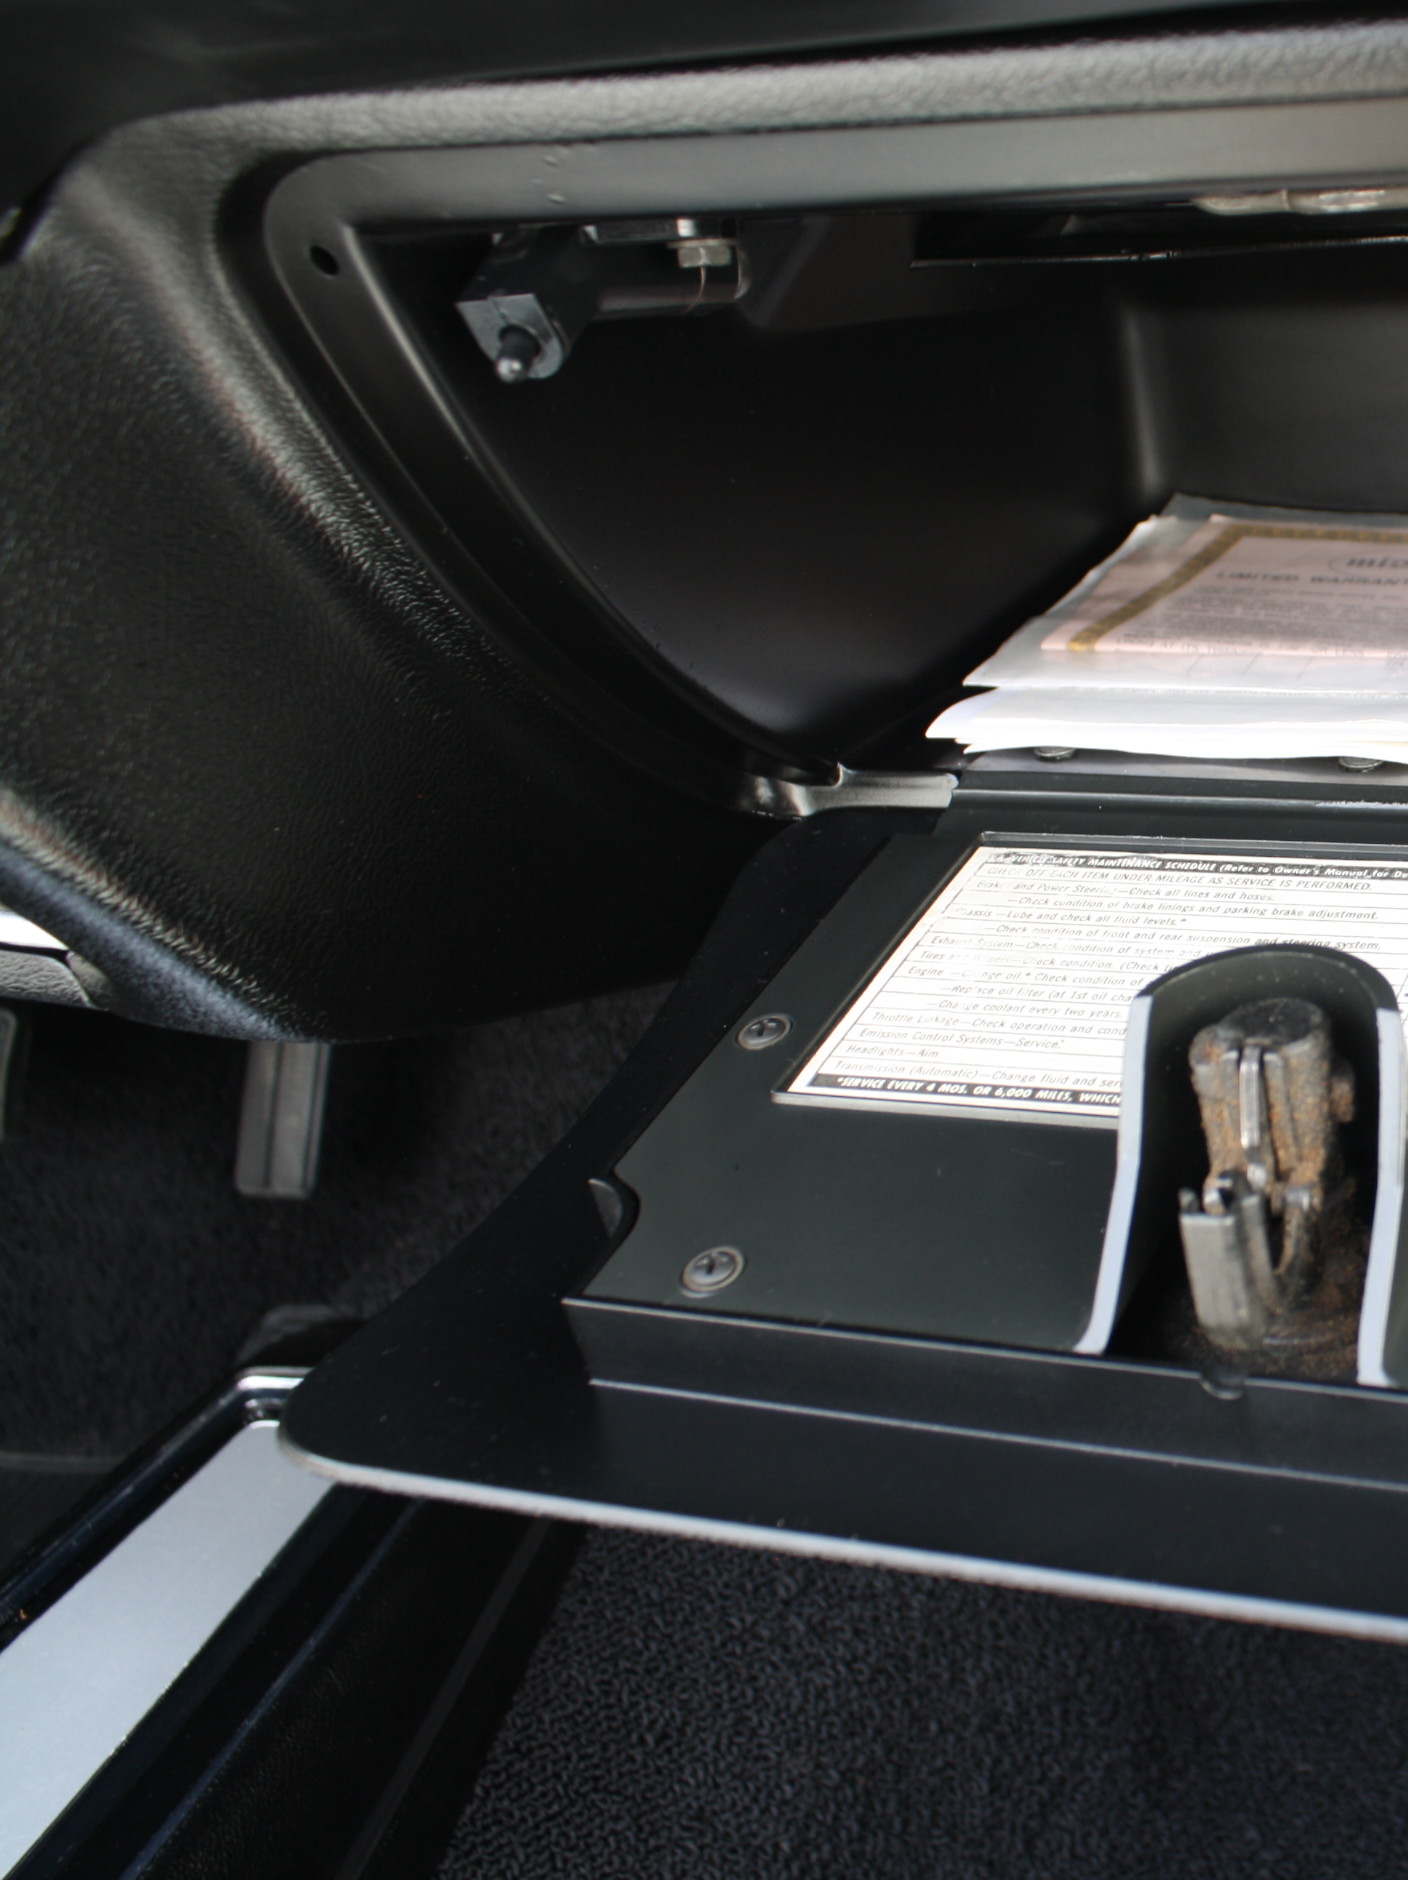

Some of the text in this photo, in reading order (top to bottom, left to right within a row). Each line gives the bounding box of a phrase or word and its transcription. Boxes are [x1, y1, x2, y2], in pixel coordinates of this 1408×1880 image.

[1087, 857, 1162, 869] MAINTENANCE
[1164, 860, 1217, 871] SCHEDULE
[1219, 863, 1254, 873] (Refer
[1257, 866, 1270, 874] to
[1324, 868, 1369, 878] Manual
[1372, 869, 1389, 878] for
[1081, 871, 1109, 880] ITEM
[1113, 873, 1152, 882] UNDER
[1155, 874, 1206, 884] MILEAGE
[1208, 877, 1224, 885] AS
[1226, 878, 1276, 887] SERVICE
[1280, 880, 1292, 888] IS
[1037, 883, 1070, 892] Power
[1164, 889, 1181, 897] all
[1183, 890, 1210, 899] lines
[1213, 892, 1236, 900] and
[1053, 898, 1104, 908] condition
[1106, 900, 1120, 909] of
[1122, 902, 1154, 910] brake
[1158, 902, 1195, 913] linings
[1199, 905, 1221, 913] and
[1222, 906, 1268, 916] parking
[1271, 908, 1304, 917] brake
[1036, 912, 1058, 921] and
[1060, 913, 1091, 922] check
[1095, 915, 1111, 923] all
[1113, 916, 1141, 925] fluid
[1086, 929, 1099, 937] of
[1102, 929, 1130, 939] front
[1133, 932, 1156, 940] and
[1186, 935, 1250, 946] suspension
[1254, 937, 1278, 946] and
[1334, 939, 1381, 950] system.
[1117, 945, 1132, 954] of
[1134, 947, 1175, 957] system
[1119, 960, 1160, 971] (Check
[907, 965, 945, 976] Engine
[1034, 972, 1068, 982] Check
[1071, 974, 1126, 984] condition
[1129, 977, 1146, 986] of
[997, 987, 1014, 996] oil
[1017, 987, 1045, 997] filter
[1048, 990, 1066, 999] (at
[1091, 991, 1108, 1001] oil
[983, 1003, 1025, 1013] coolant
[1028, 1006, 1060, 1016] every
[1063, 1007, 1085, 1016] two
[1088, 1009, 1122, 1019] years.
[871, 1011, 914, 1023] Throttle
[1009, 1021, 1067, 1032] operation
[1068, 1024, 1094, 1033] and
[859, 1027, 908, 1039] Emission
[912, 1030, 956, 1042] Control
[834, 1060, 906, 1073] Transmission
[1039, 1073, 1070, 1084] fluid
[1072, 1076, 1098, 1086] and
[887, 1080, 925, 1091] EVERY
[926, 1083, 936, 1092] 4
[937, 1083, 968, 1094] MOS.
[972, 1085, 992, 1096] OR
[994, 1087, 1032, 1098] 6,000
[1035, 1090, 1073, 1102] MILES,
[1079, 1092, 1122, 1104] WHICH
